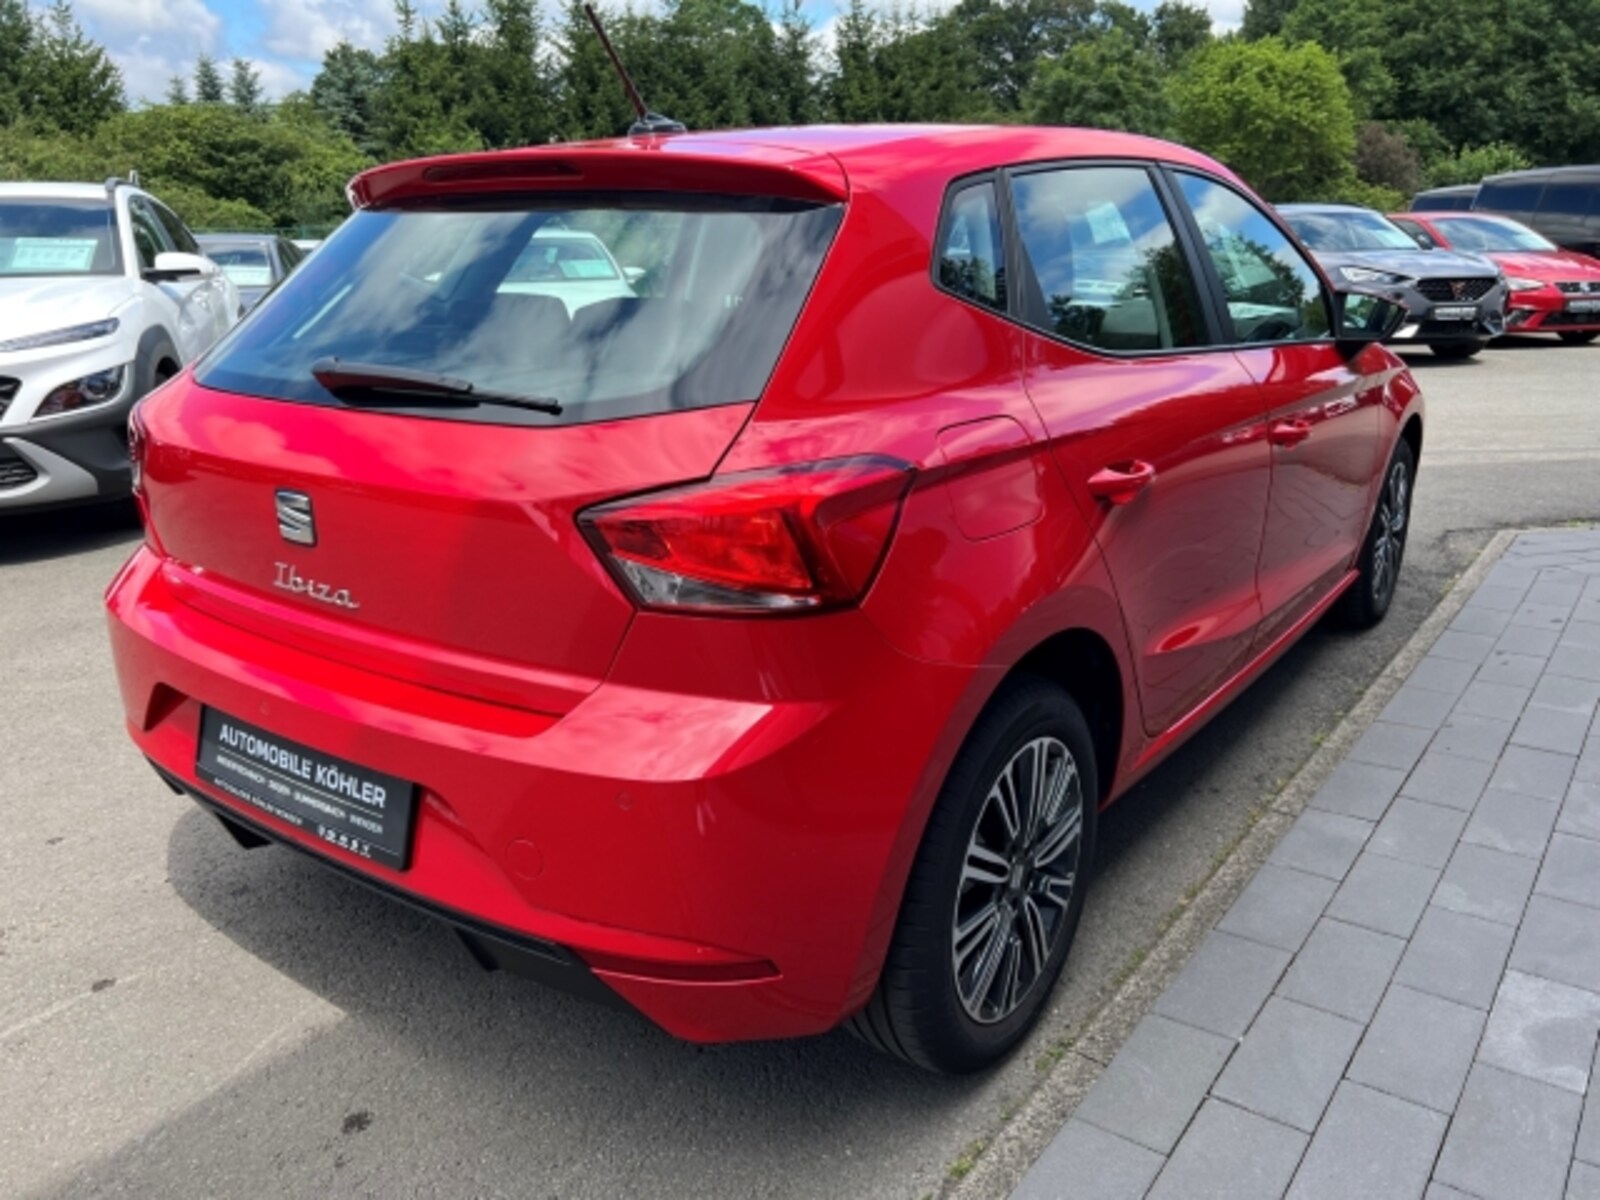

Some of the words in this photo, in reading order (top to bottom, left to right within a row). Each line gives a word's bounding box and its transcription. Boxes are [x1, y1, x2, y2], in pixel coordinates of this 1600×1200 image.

[273, 562, 360, 608] Ibiza
[219, 724, 312, 779] AUTOMOBILE
[315, 764, 387, 808] KÖHLER
